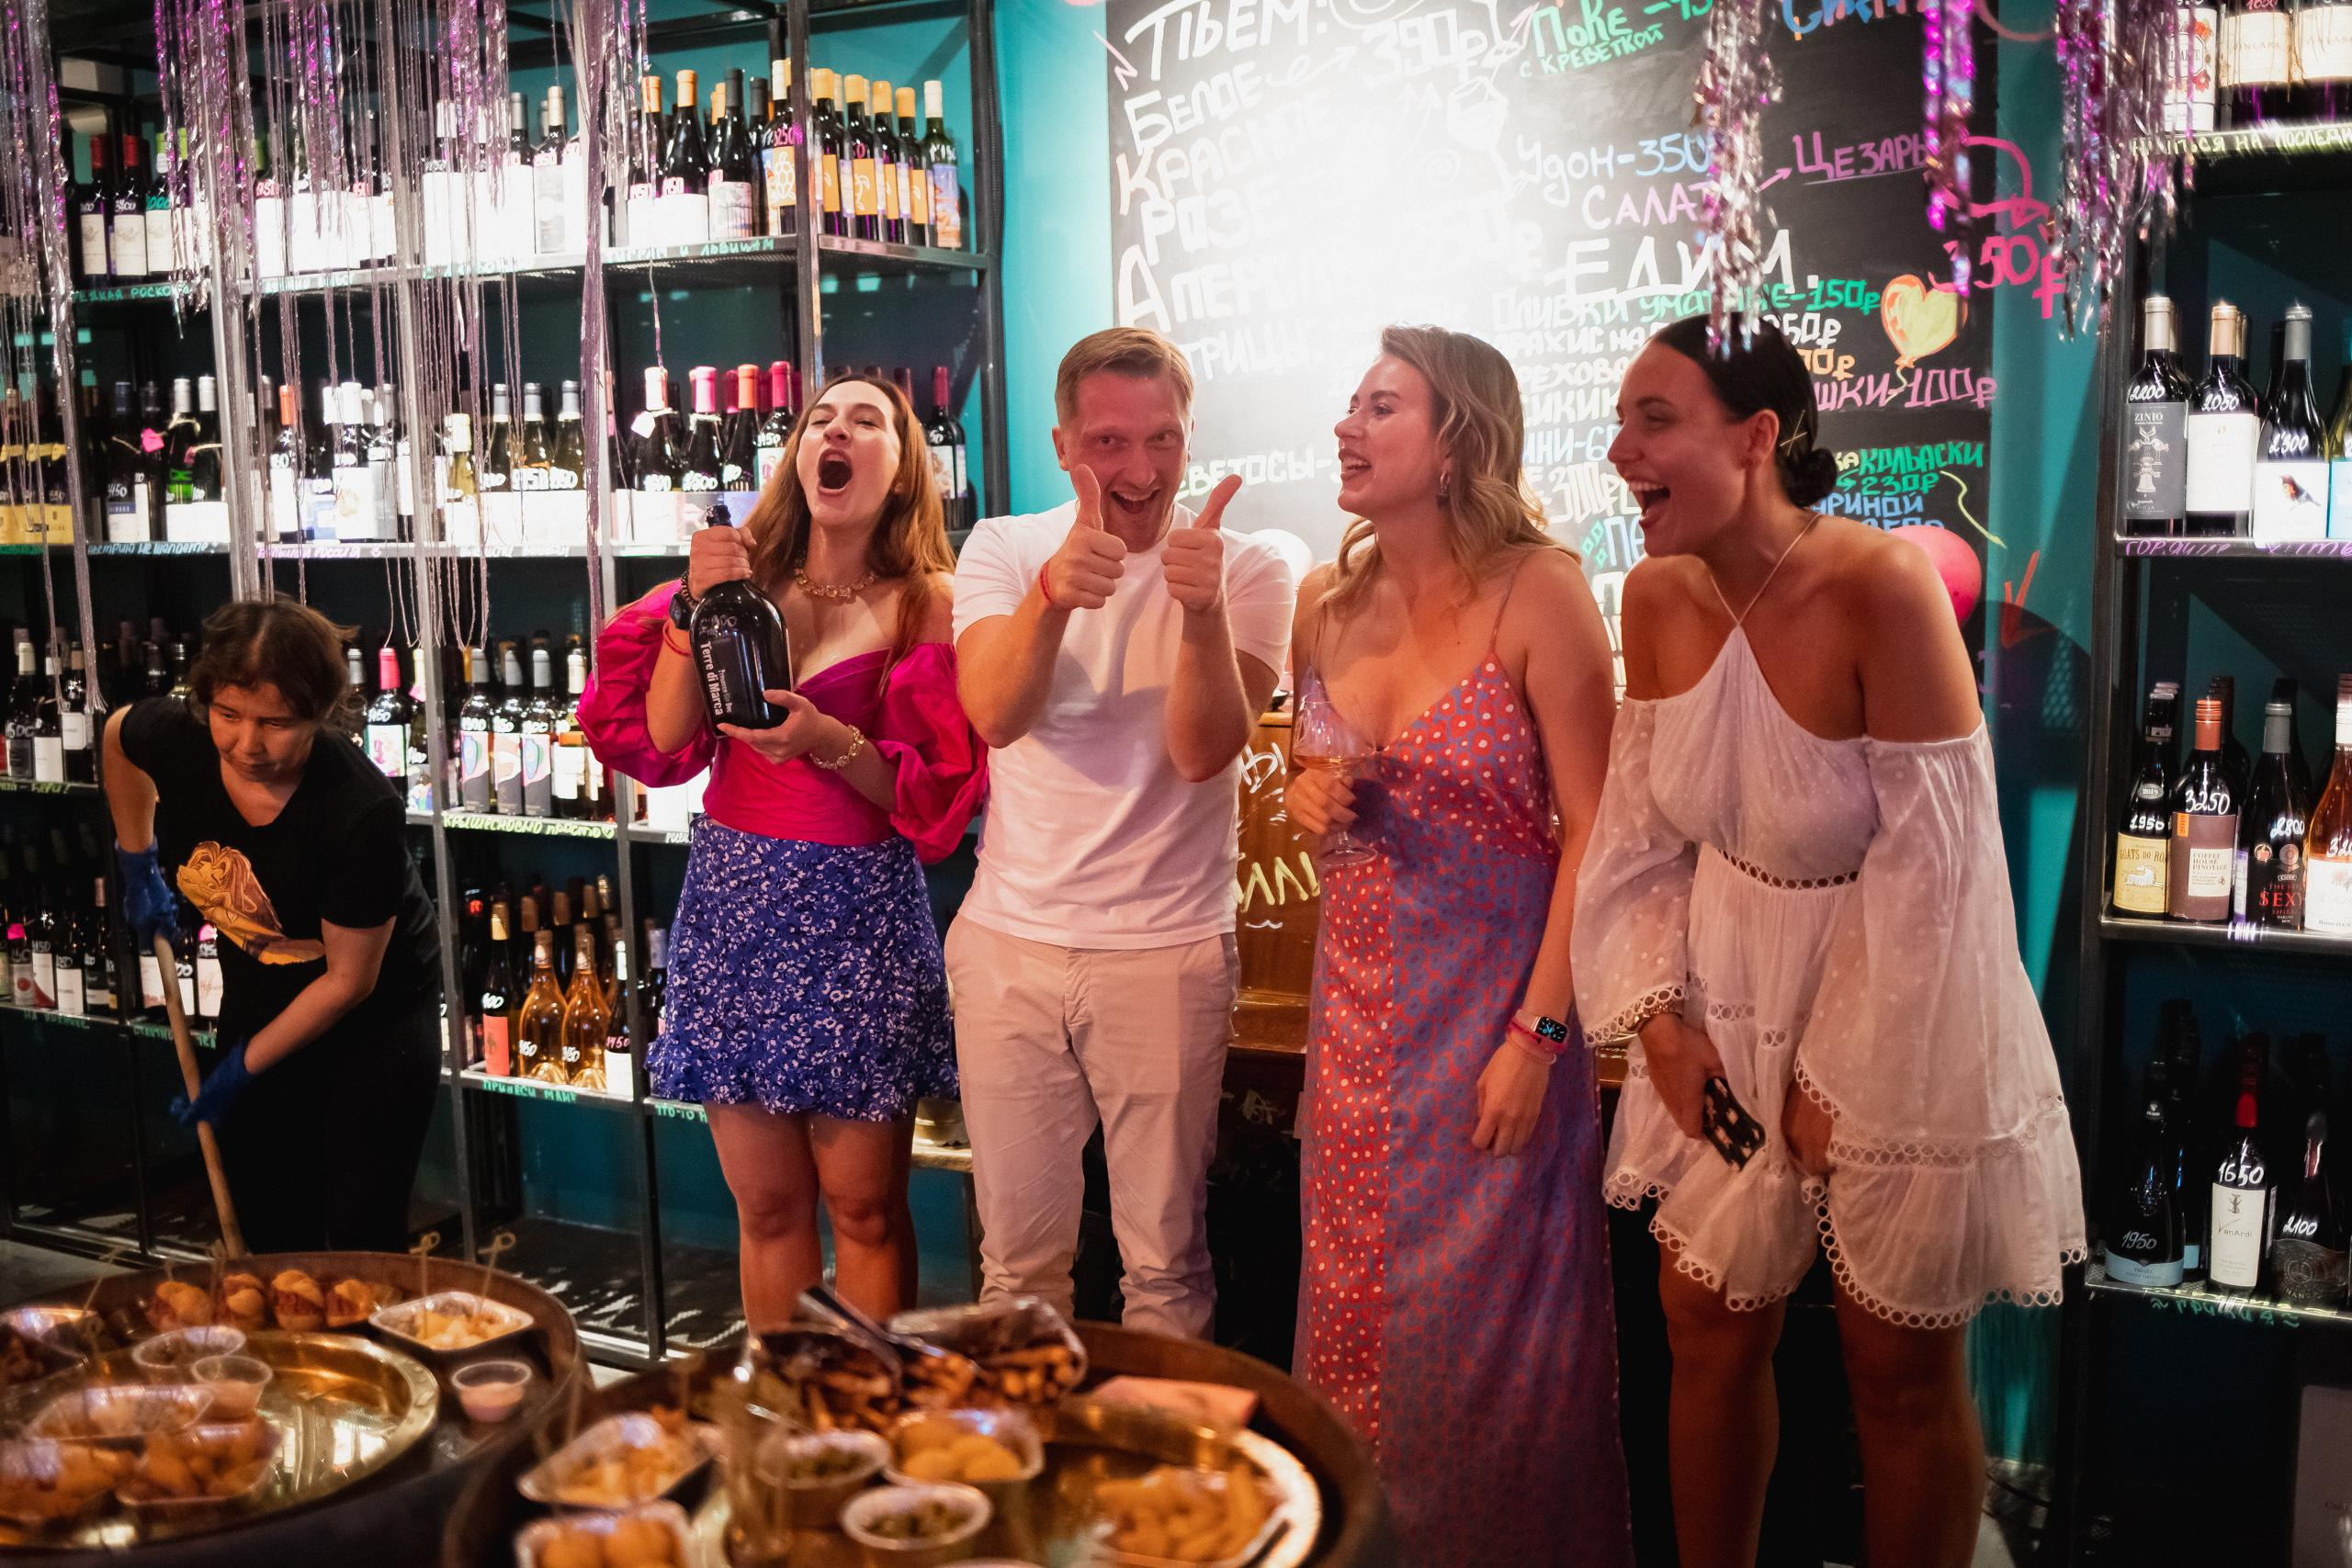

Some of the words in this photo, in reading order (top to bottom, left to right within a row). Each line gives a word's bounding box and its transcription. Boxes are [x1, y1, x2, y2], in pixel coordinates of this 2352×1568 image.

[2134, 412, 2164, 422] ZINIO
[700, 640, 714, 671] Terre
[707, 671, 719, 682] di
[708, 681, 724, 716] Marca
[2185, 789, 2231, 816] 3250
[2219, 1162, 2264, 1186] 1650
[2121, 1230, 2157, 1249] 1950
